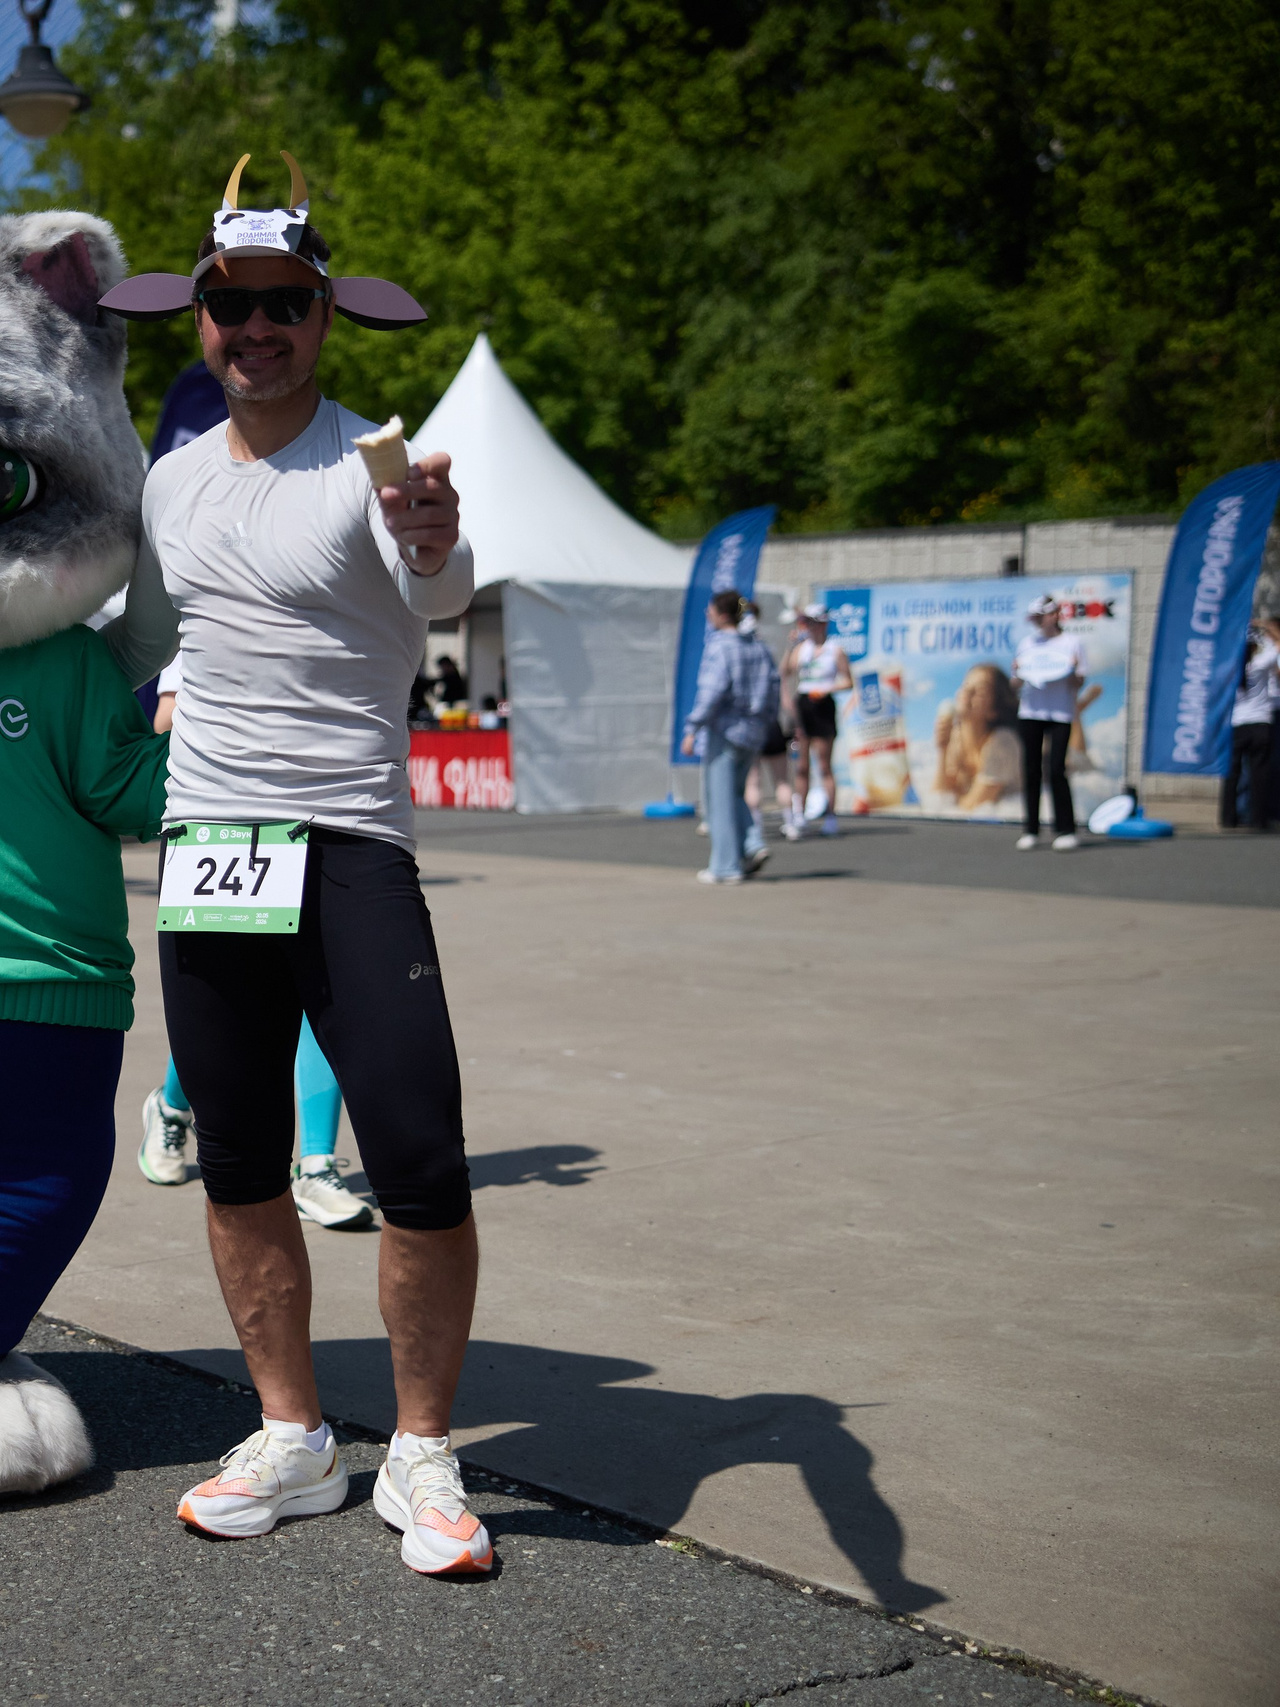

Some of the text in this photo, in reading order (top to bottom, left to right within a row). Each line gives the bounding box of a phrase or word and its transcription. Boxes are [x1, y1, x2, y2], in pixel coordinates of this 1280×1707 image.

[236, 231, 277, 240] РОДИМАЯ
[236, 237, 278, 246] СТОРОНКА
[881, 593, 1018, 618] НА СЕДЬМОМ НЕБЕ
[882, 622, 910, 655] ОТ
[919, 620, 1016, 655] СЛИВОК
[1172, 495, 1245, 765] РОДИМАЯ СТОРОНКА
[230, 830, 252, 840] Звук
[193, 857, 272, 896] 247
[183, 908, 196, 926] A
